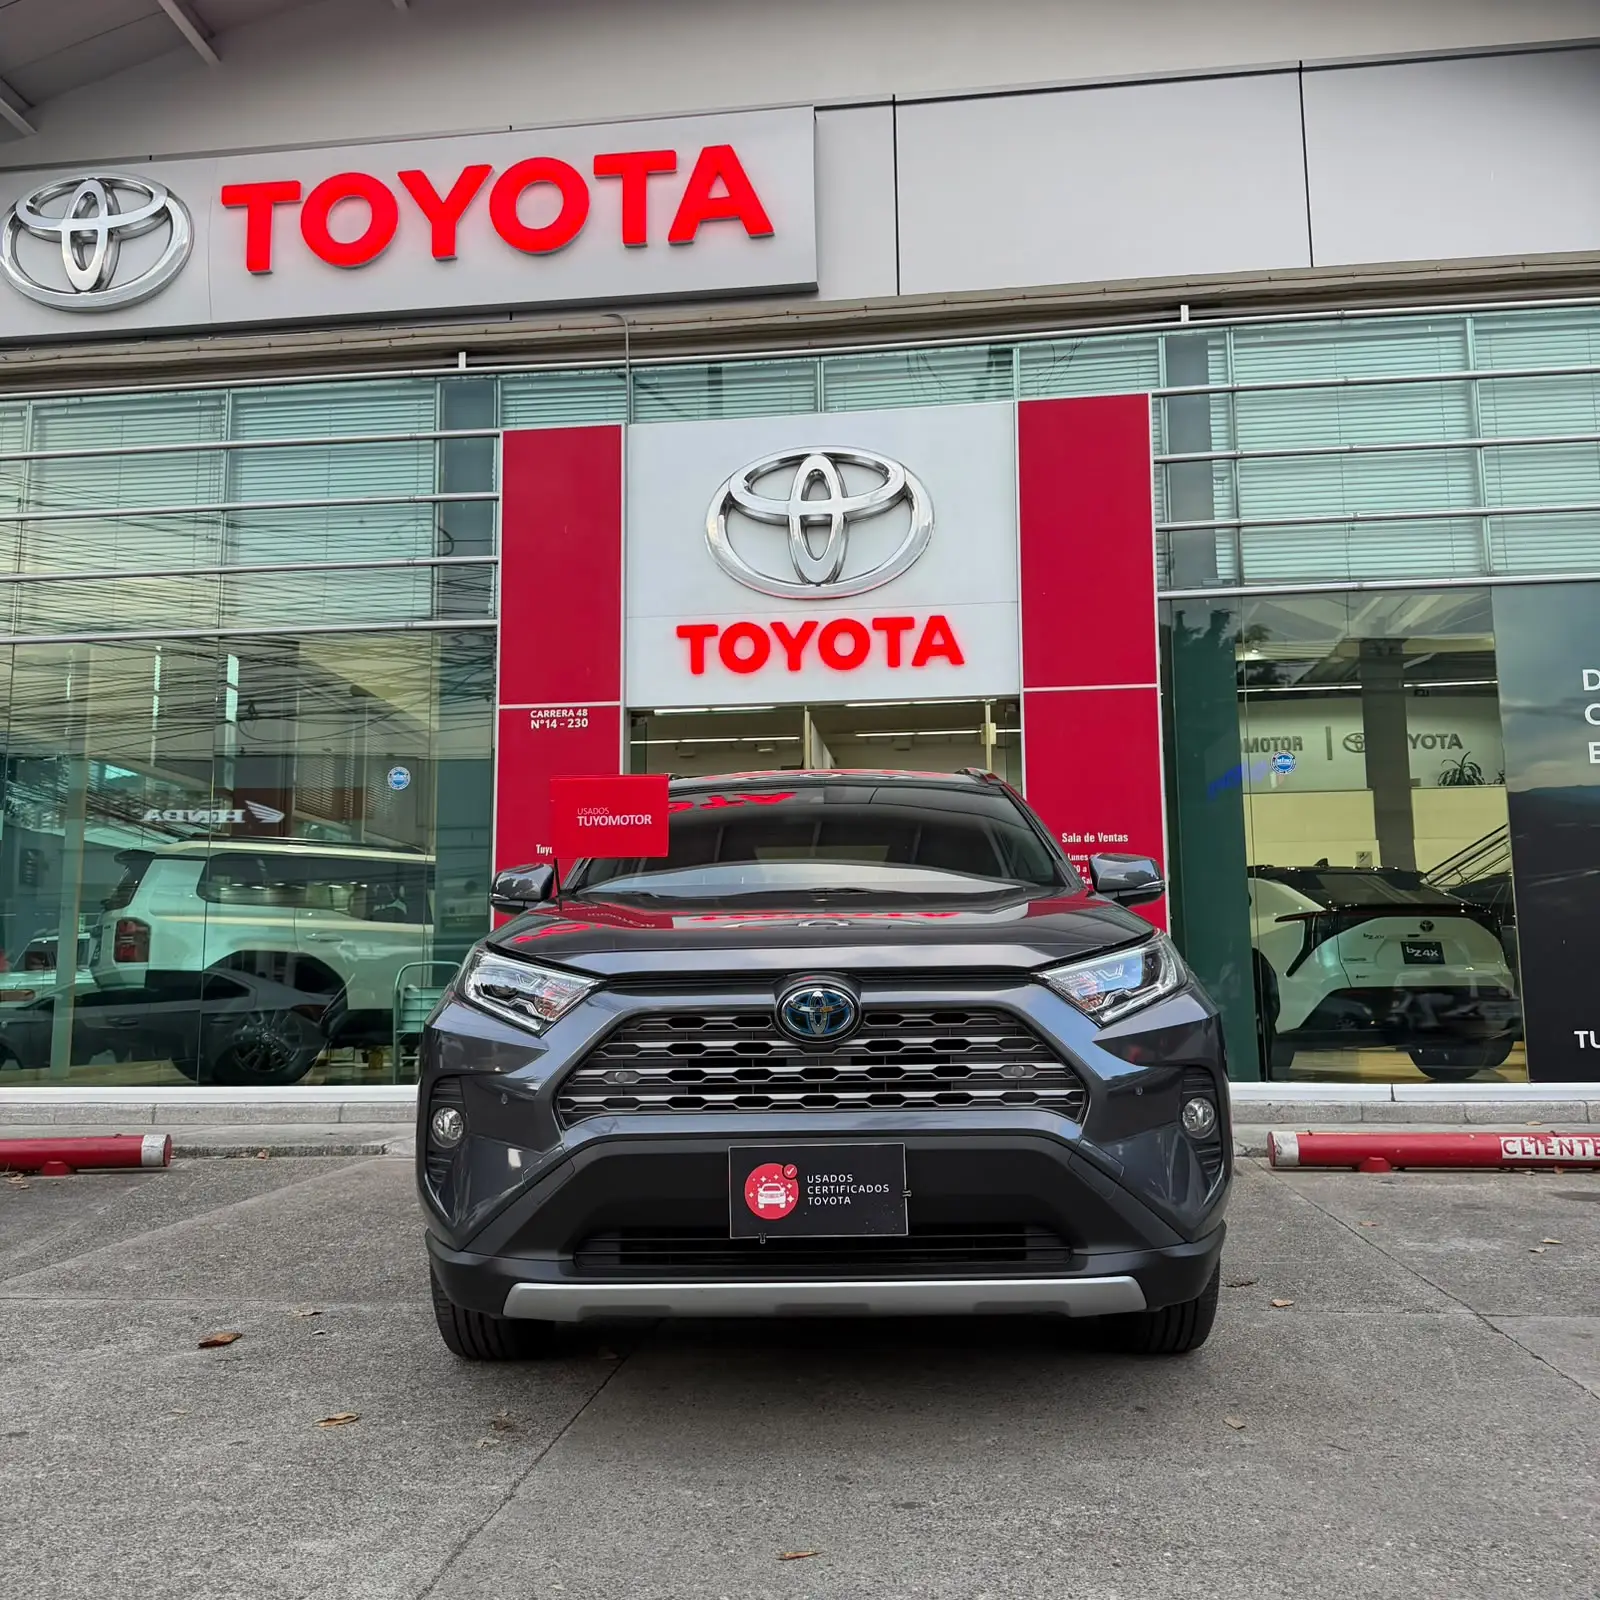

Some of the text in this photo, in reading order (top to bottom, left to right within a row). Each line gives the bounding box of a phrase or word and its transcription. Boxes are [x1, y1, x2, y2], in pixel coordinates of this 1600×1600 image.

[221, 144, 775, 275] TOYOTA
[676, 615, 965, 675] TOYOTA
[530, 708, 588, 718] CARRERA 48
[567, 717, 589, 728] 230
[1243, 733, 1463, 753] MOTOR YOTA
[577, 807, 610, 815] USADOS
[576, 814, 652, 826] TUYOMOTOR
[1061, 832, 1128, 843] Sala de Ventas
[1573, 1030, 1600, 1049] TU
[807, 1174, 853, 1183] USADOS
[807, 1184, 889, 1194] CERTIFICADOS
[807, 1196, 851, 1205] TOYOTA
